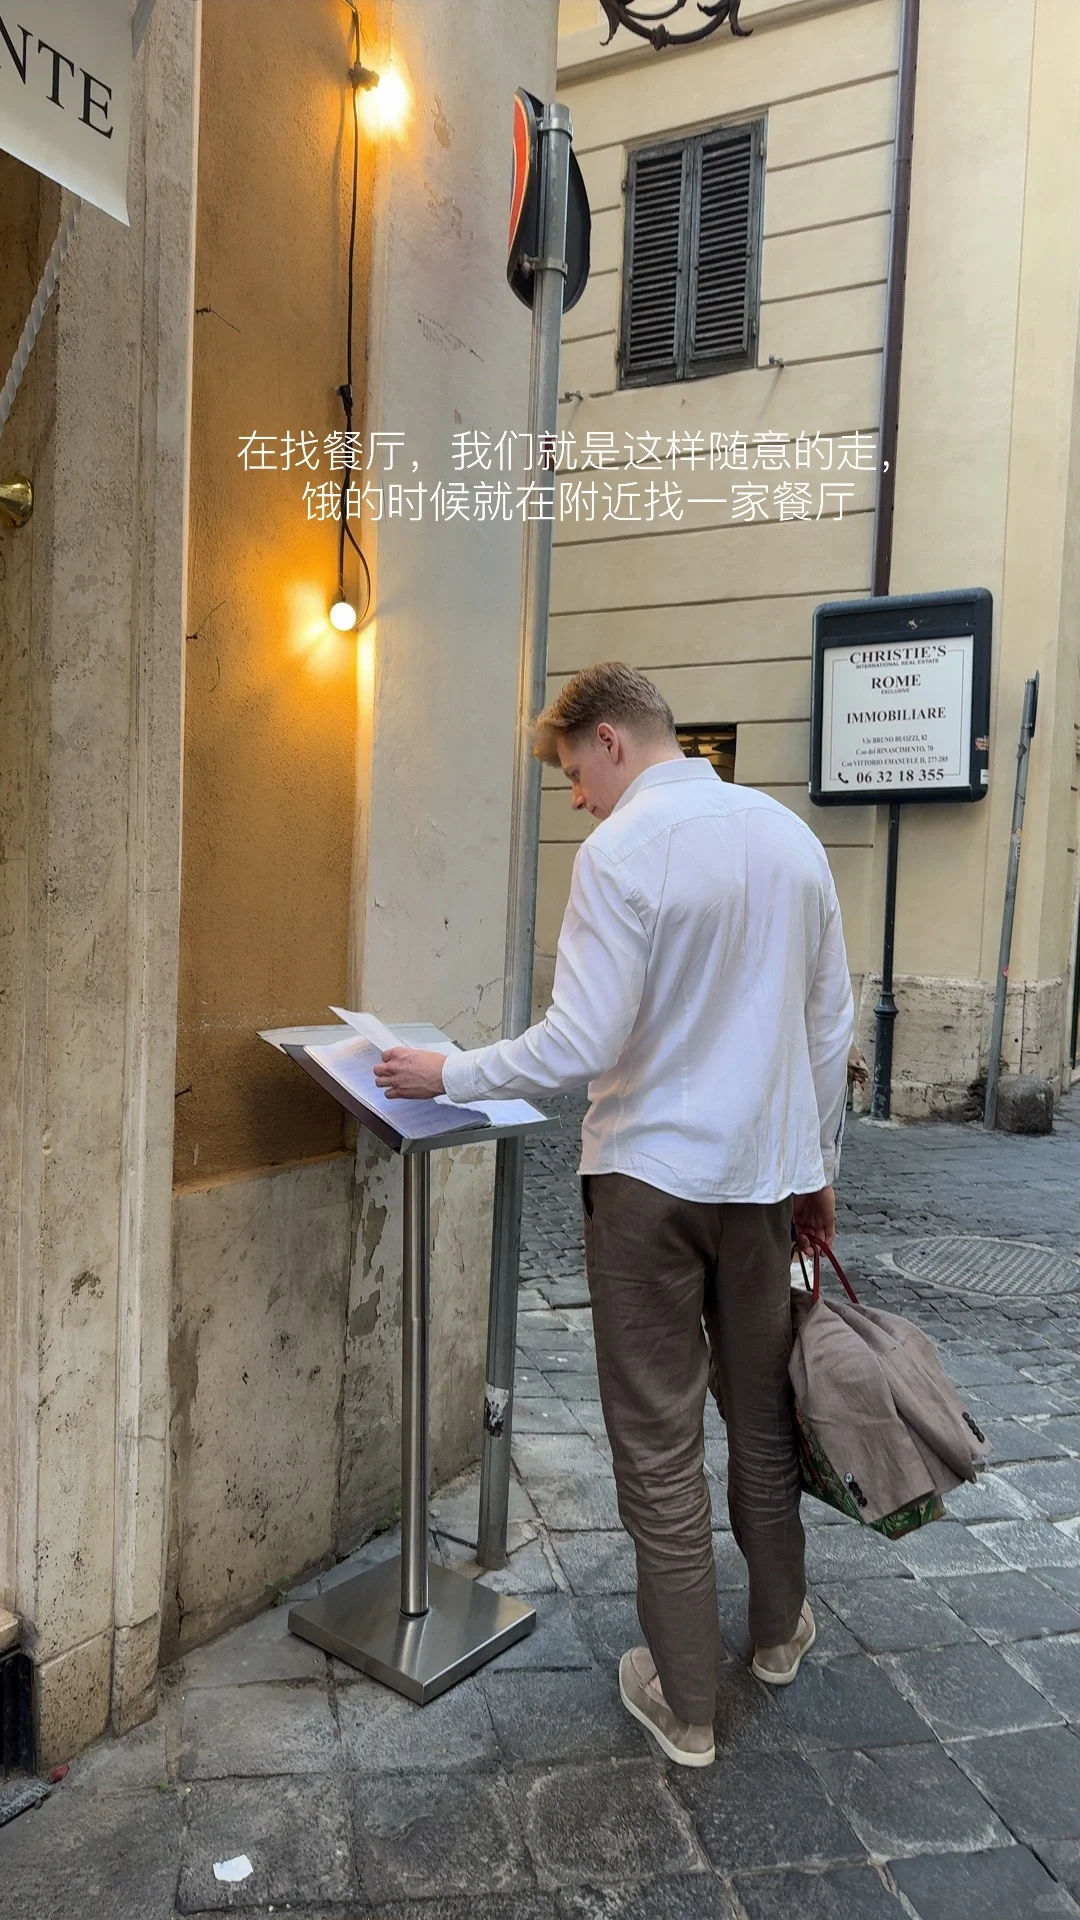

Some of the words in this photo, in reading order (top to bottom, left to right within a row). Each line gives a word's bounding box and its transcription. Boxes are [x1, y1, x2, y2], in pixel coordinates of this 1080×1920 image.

[849, 644, 947, 664] CHRISTIE'S
[855, 662, 900, 670] INTERNATIONAL
[871, 674, 921, 689] ROME
[846, 707, 947, 724] IMMOBILIARE
[872, 736, 894, 744] BRUNO
[853, 759, 883, 767] VITTORIO
[884, 757, 918, 766] EMANUELE
[856, 771, 873, 784] 06
[876, 770, 893, 783] 32
[899, 769, 914, 782] 18
[918, 768, 945, 782] 355
